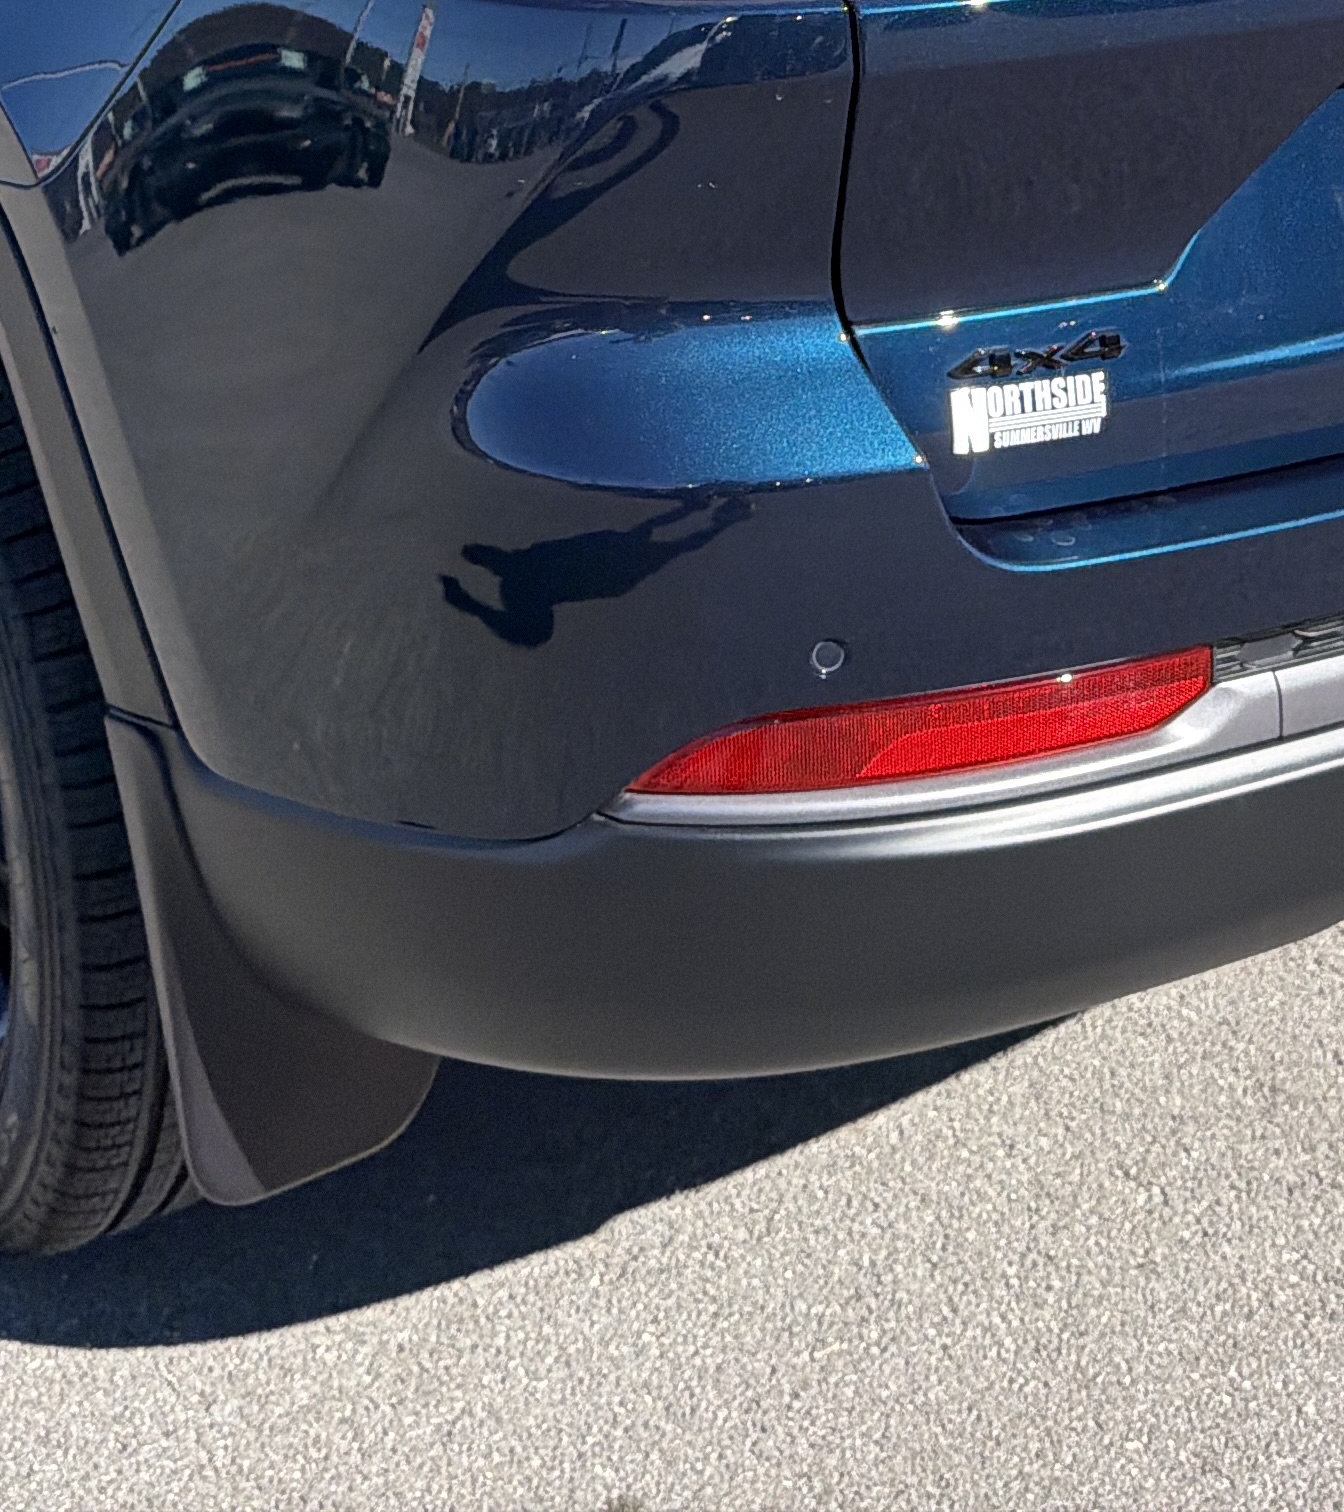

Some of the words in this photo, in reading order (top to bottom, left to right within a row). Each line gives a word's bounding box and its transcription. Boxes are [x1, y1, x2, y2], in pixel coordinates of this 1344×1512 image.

[951, 371, 1108, 455] NORTHSIDE
[993, 420, 1080, 449] SUMMERSVILLE
[1081, 417, 1102, 436] WV
